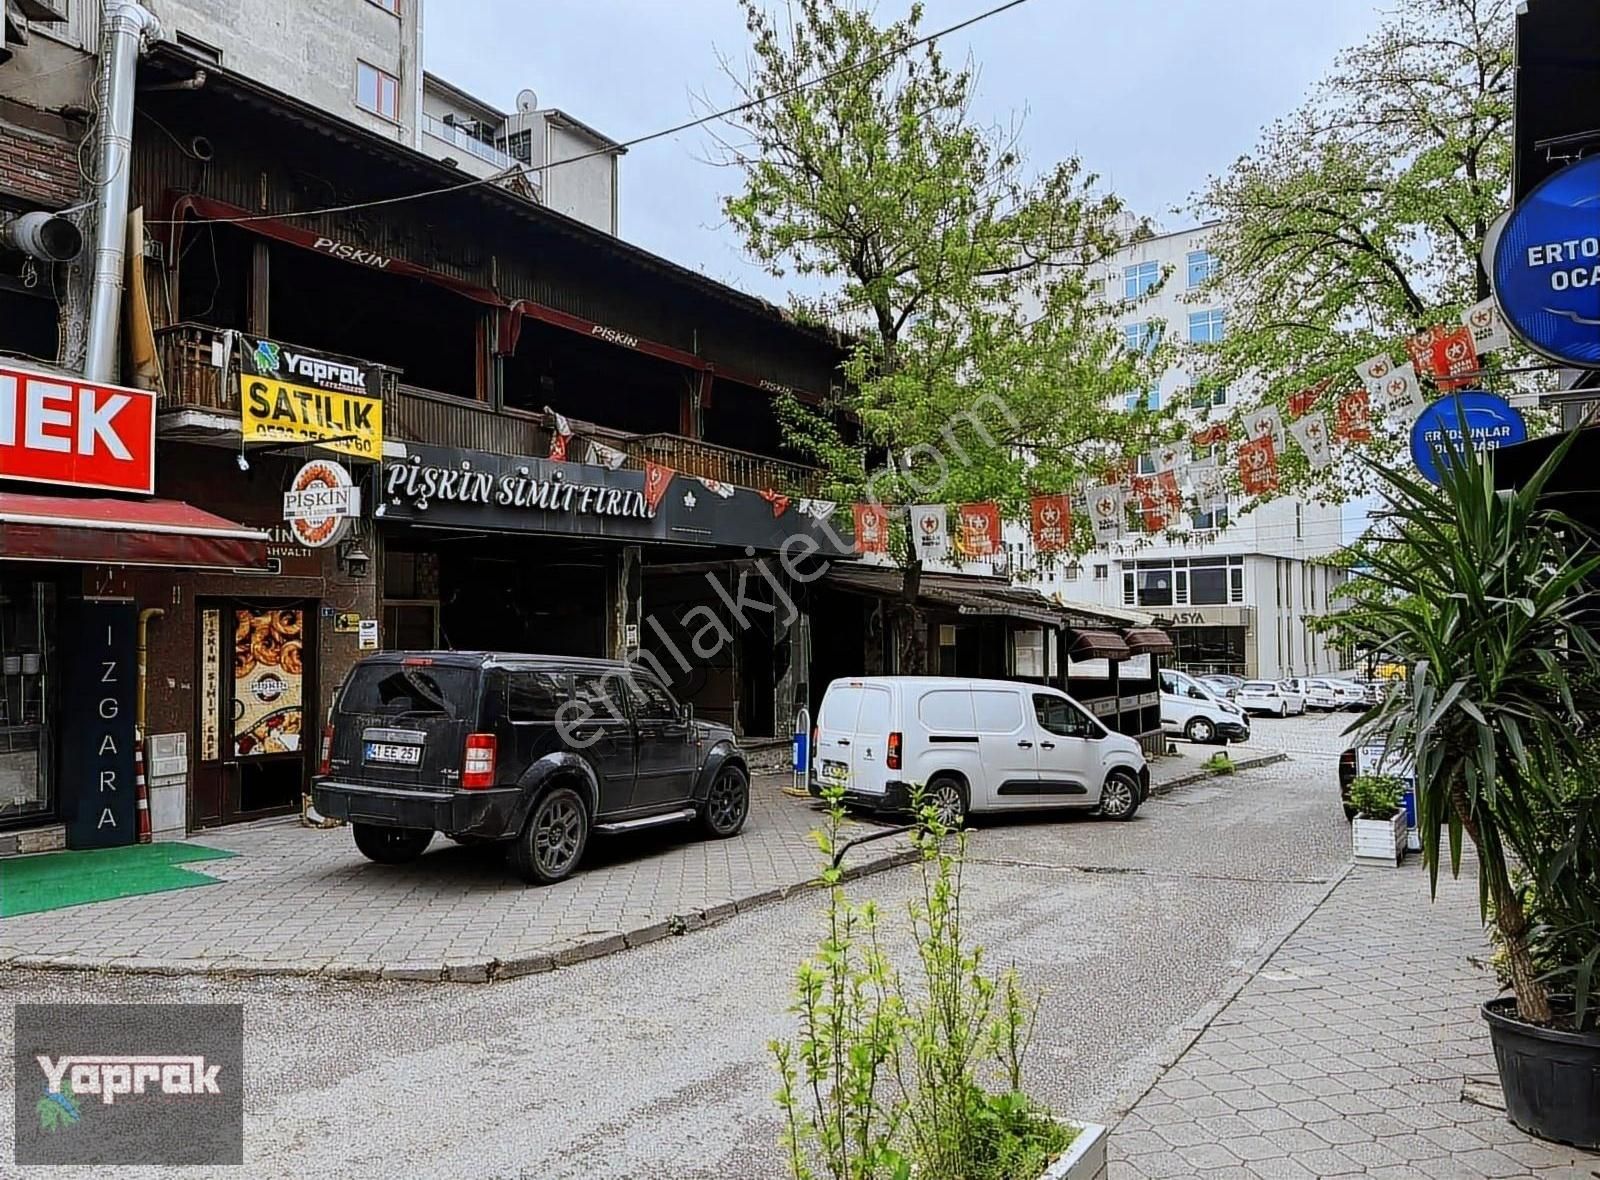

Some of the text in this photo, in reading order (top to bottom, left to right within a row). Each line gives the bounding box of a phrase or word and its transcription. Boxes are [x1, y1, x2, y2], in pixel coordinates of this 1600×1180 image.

[284, 352, 366, 387] Yaprak
[249, 382, 373, 430] SATILIK
[1424, 426, 1510, 442] EROSNLAR
[286, 488, 347, 509] PİŞKİN
[387, 455, 657, 519] PİŞKİN SİMİT FIRIN
[1172, 612, 1205, 624] ASYA
[97, 624, 119, 830] IZGARA
[383, 745, 397, 762] EE
[399, 747, 418, 763] 251
